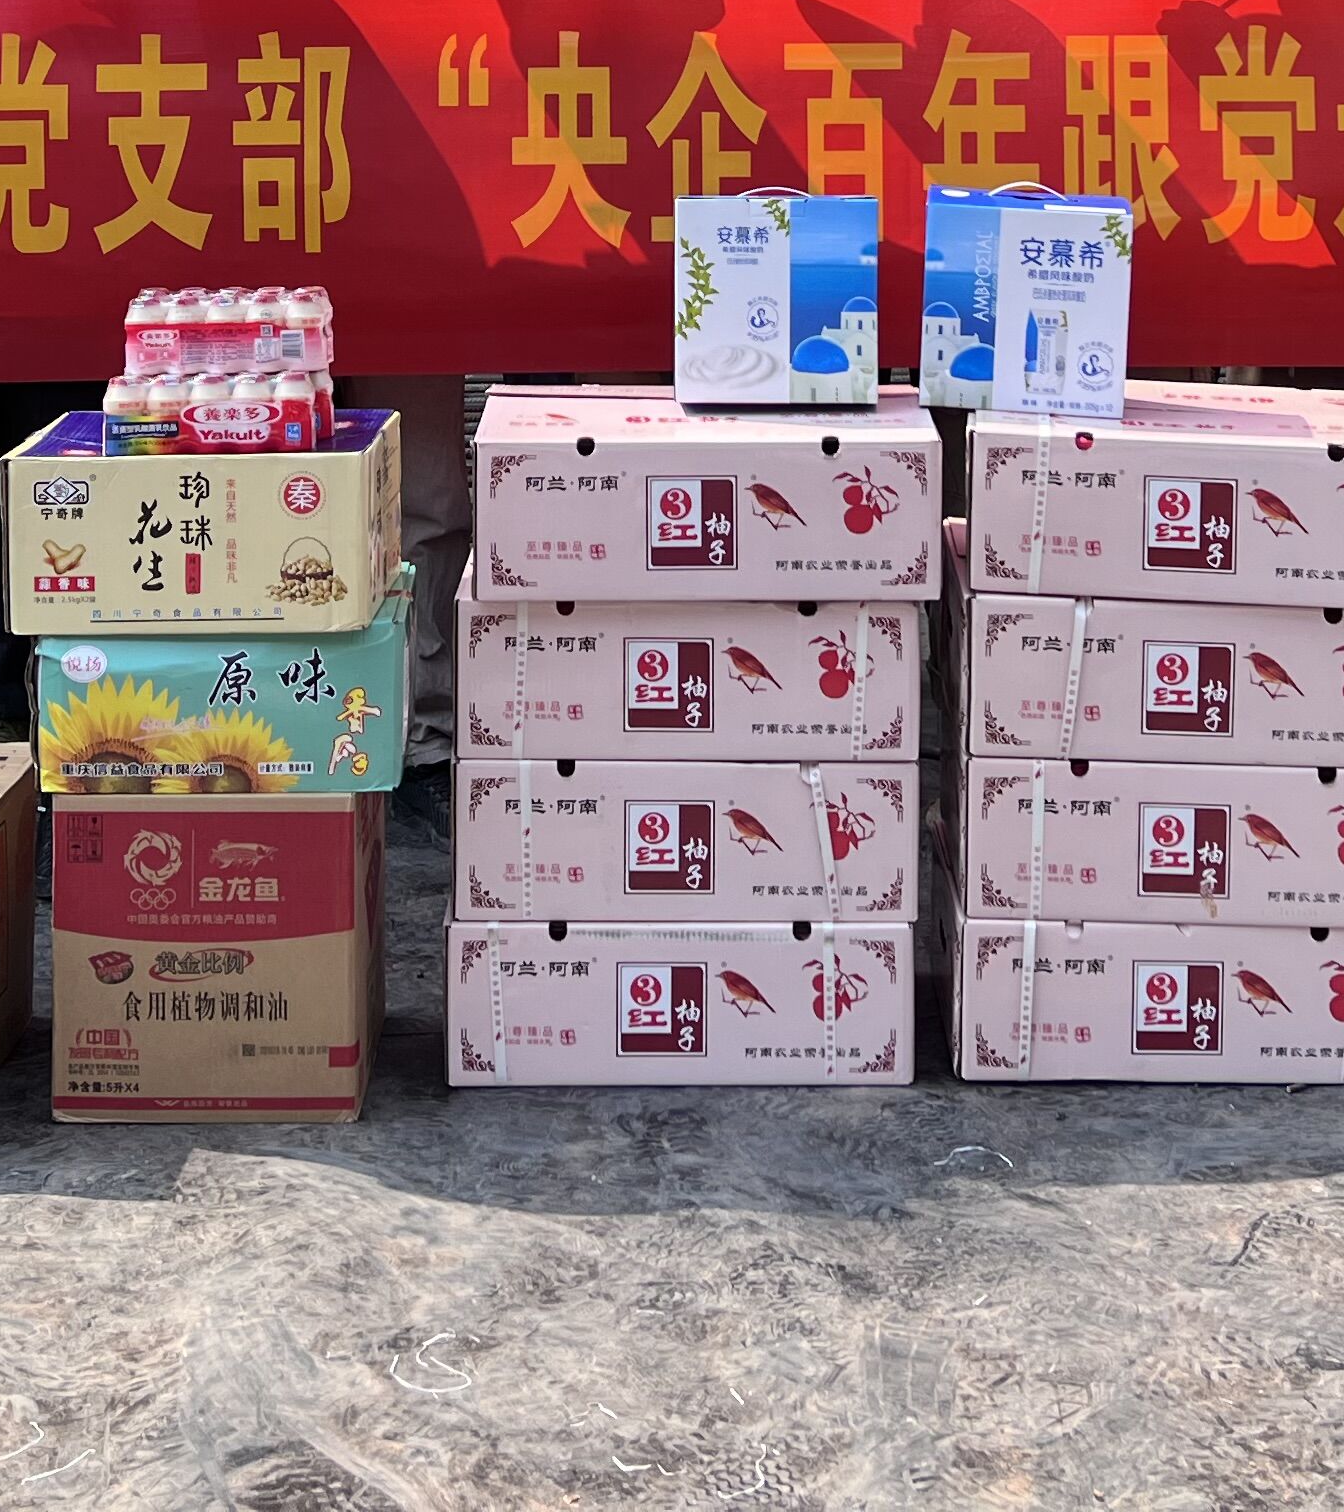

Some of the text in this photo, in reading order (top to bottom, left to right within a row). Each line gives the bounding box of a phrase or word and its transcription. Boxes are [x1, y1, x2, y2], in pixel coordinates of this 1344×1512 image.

[717, 226, 770, 245] 安慕希
[1019, 237, 1105, 270] 安慕希
[199, 428, 266, 441] Yakult
[525, 475, 619, 491] 阿兰·阿南
[40, 507, 84, 520] 宁奇牌
[179, 471, 213, 551] 珍珠
[226, 478, 237, 584] 来自天然 品味非凡
[129, 499, 173, 592] 花生
[704, 511, 731, 565] 柚子
[1202, 514, 1232, 568] 柚子
[775, 559, 893, 571] 阿南农业荣誉出品
[92, 607, 283, 619] 四川宁奇食品有限公司
[208, 647, 336, 706] 原味
[680, 674, 708, 728] 柚子
[1200, 679, 1229, 732] 柚子
[59, 761, 225, 777] 重庆信益食品有限公司
[681, 836, 709, 890] 柚子
[1196, 840, 1225, 890] 柚子
[198, 876, 280, 903] 金龙鱼
[154, 951, 246, 976] 黄金比例
[122, 990, 289, 1022] 食用植物调和油
[675, 998, 701, 1052] 柚子
[1189, 996, 1217, 1050] 柚子
